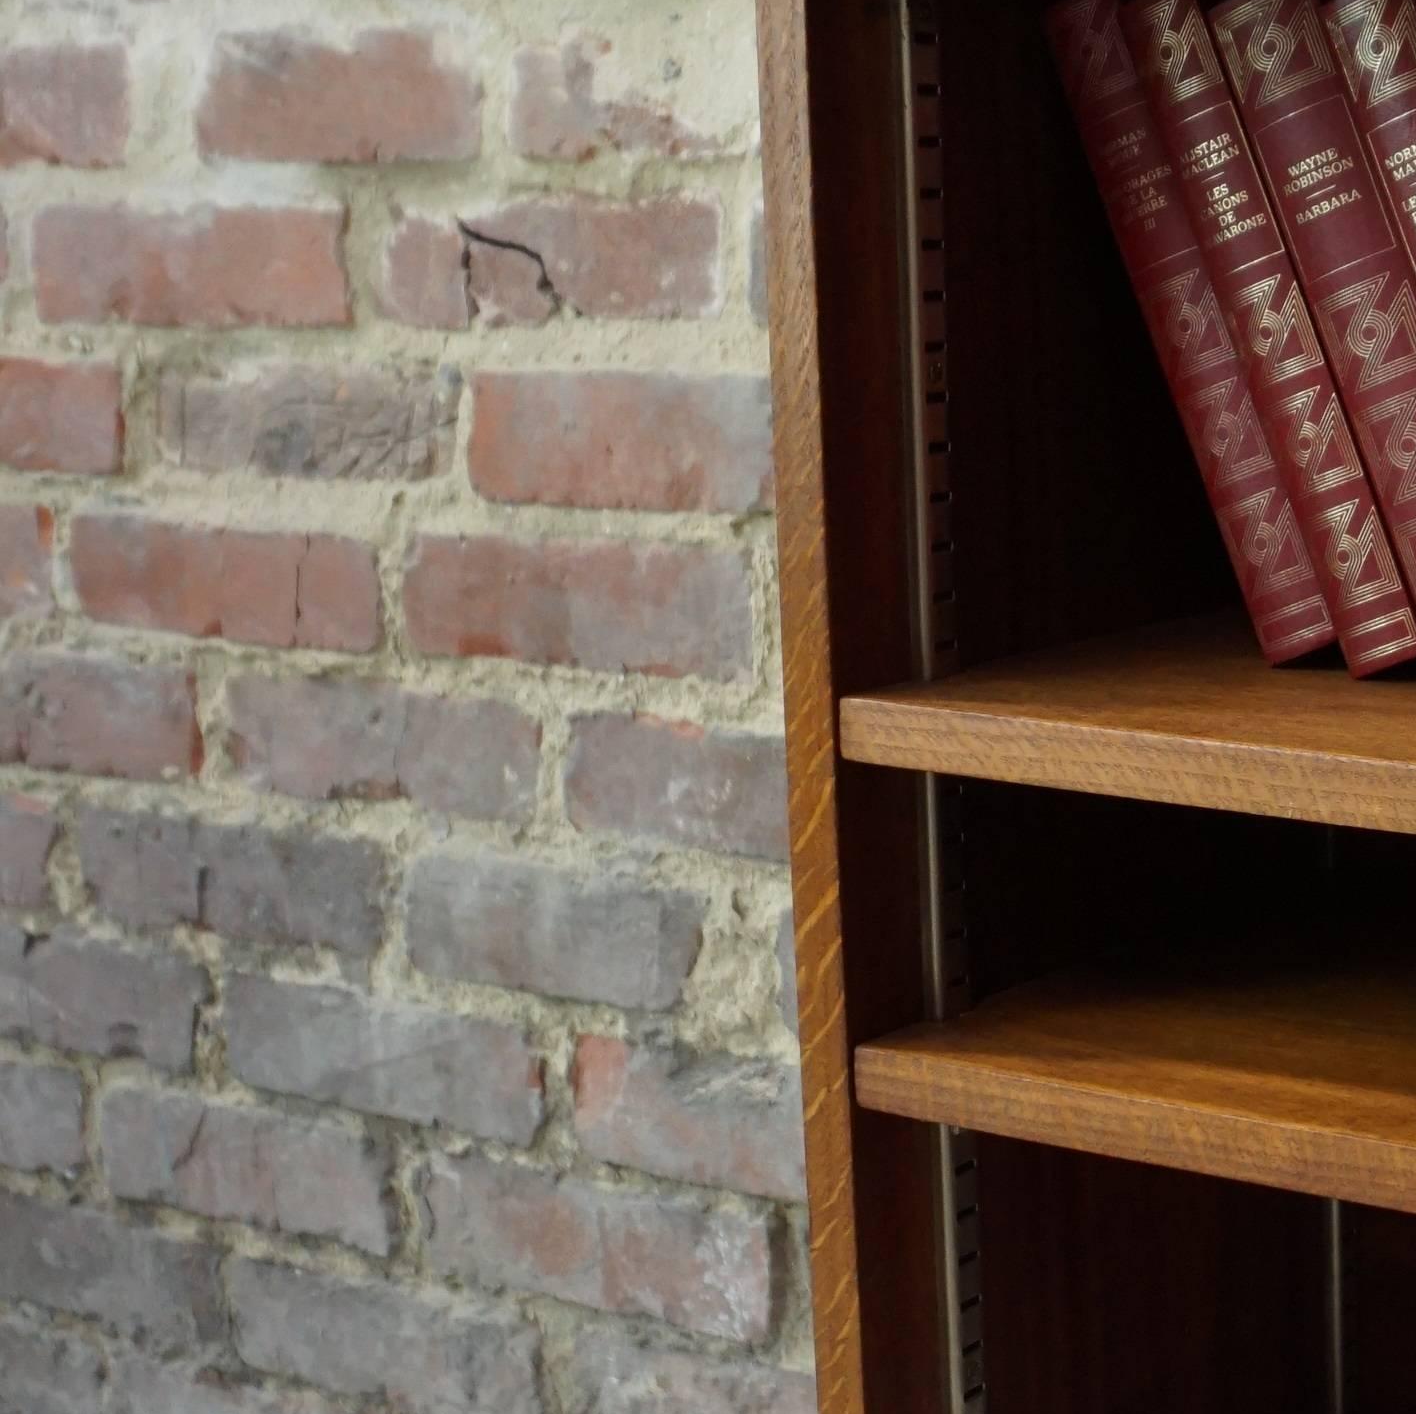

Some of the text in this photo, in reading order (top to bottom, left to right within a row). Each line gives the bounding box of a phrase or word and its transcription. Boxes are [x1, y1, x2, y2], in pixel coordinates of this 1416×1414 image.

[1283, 156, 1354, 196] ROBINSON
[1288, 147, 1338, 177] WAYNE
[1207, 183, 1229, 202] LES
[1295, 189, 1362, 225] BARBARA
[1218, 210, 1237, 227] DE
